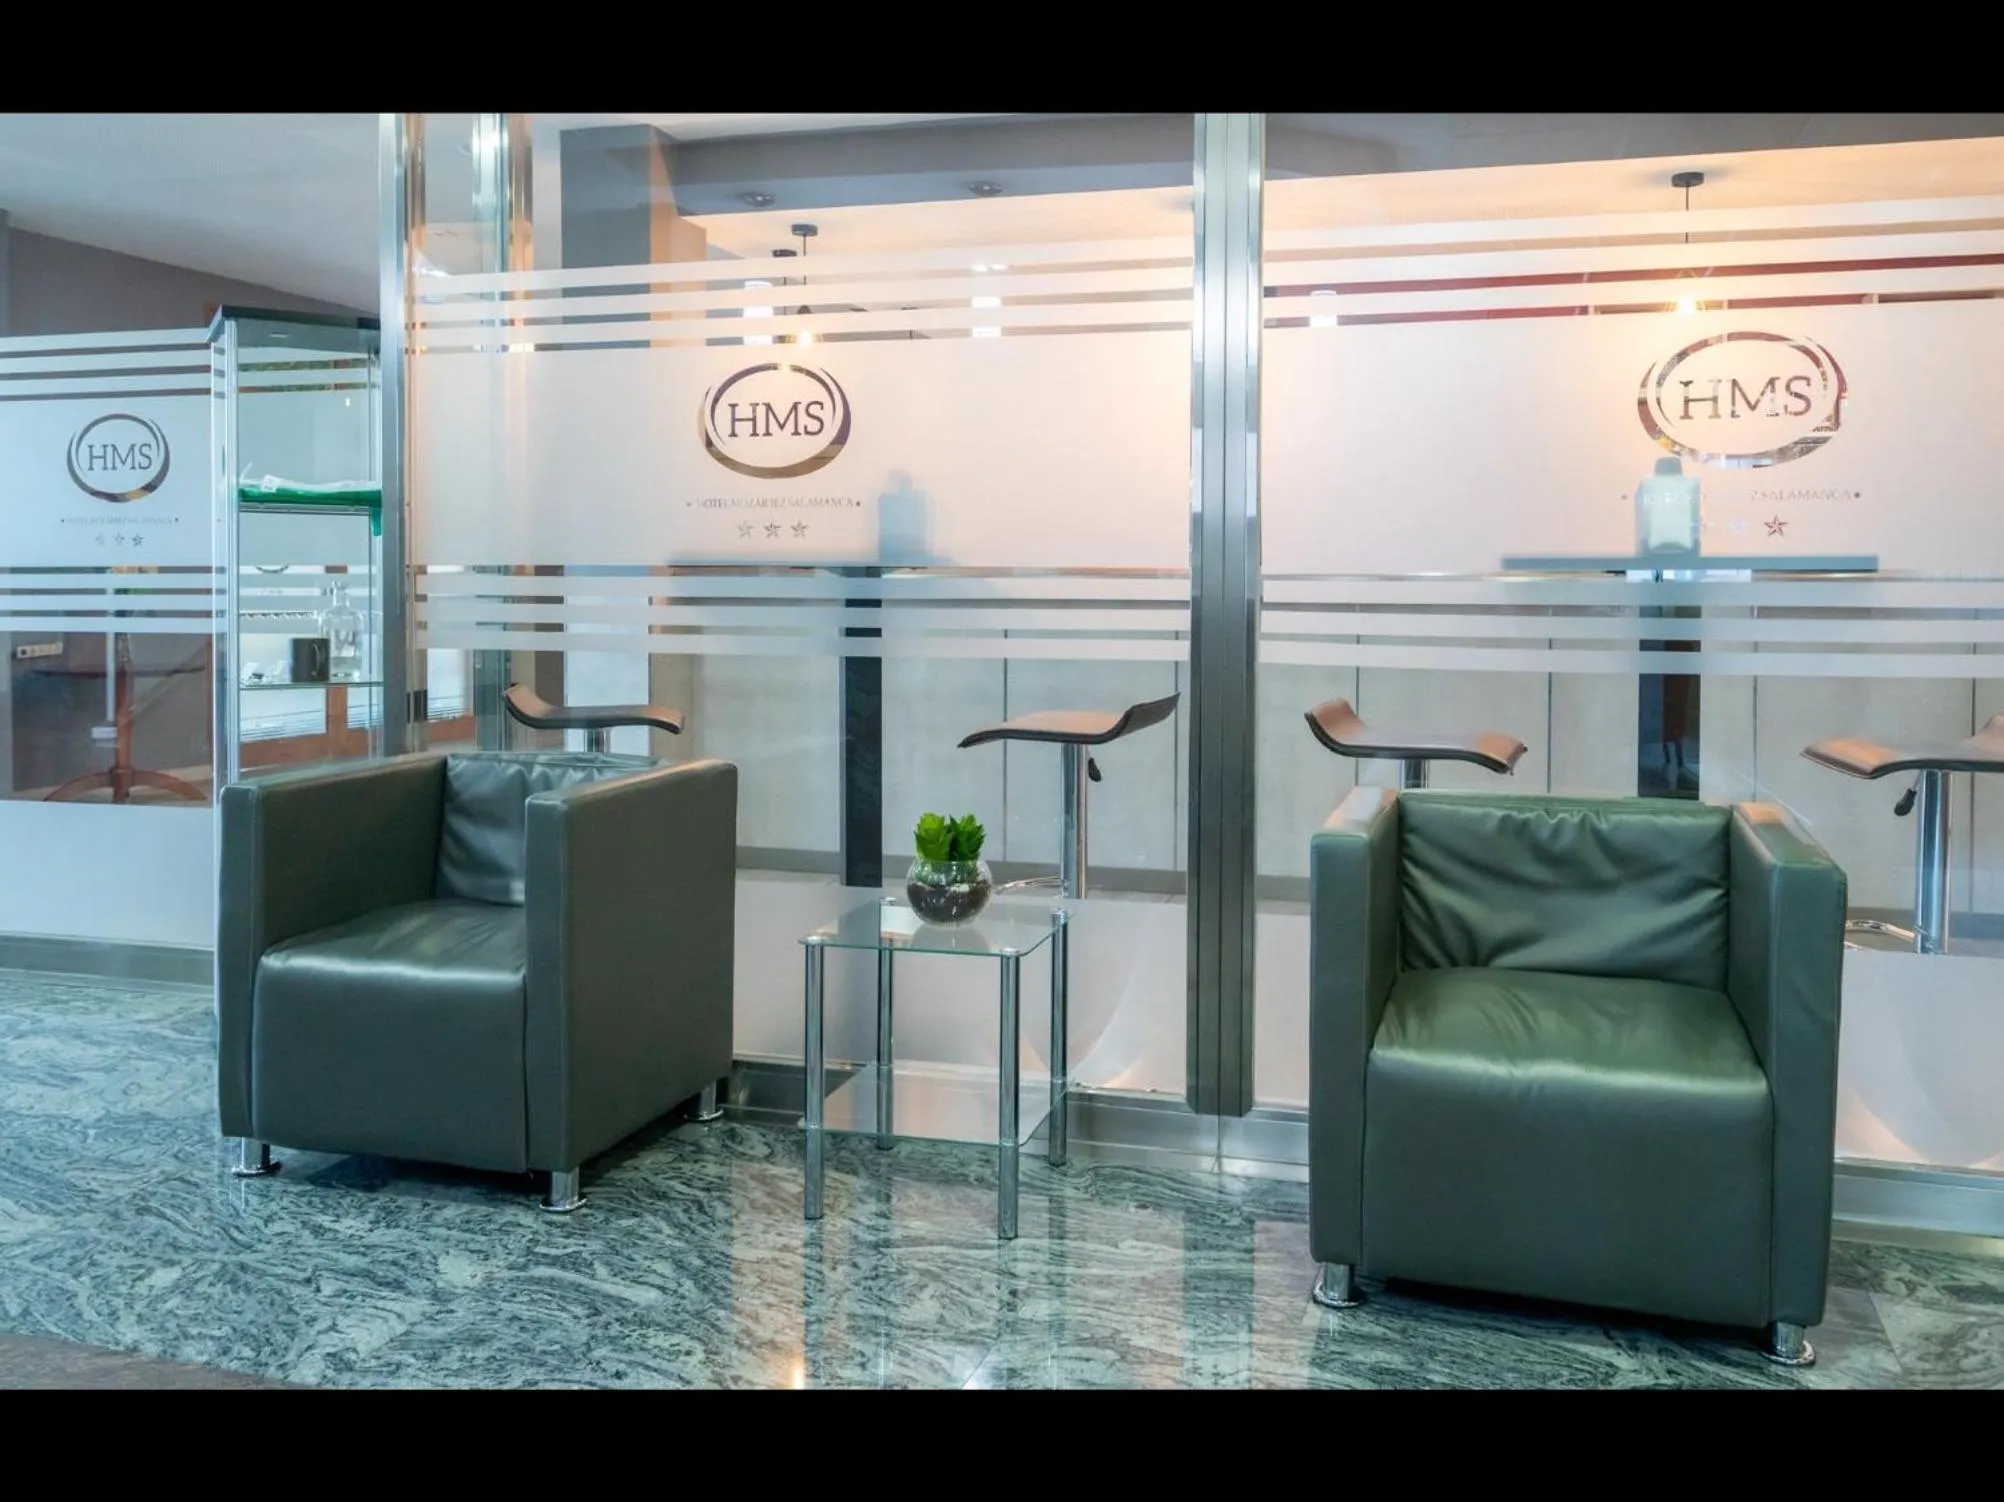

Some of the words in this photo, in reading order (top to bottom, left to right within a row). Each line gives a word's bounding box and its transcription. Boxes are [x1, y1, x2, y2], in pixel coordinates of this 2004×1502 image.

[1679, 375, 1812, 419] HMS
[728, 400, 825, 437] HMS
[87, 442, 153, 471] HMS
